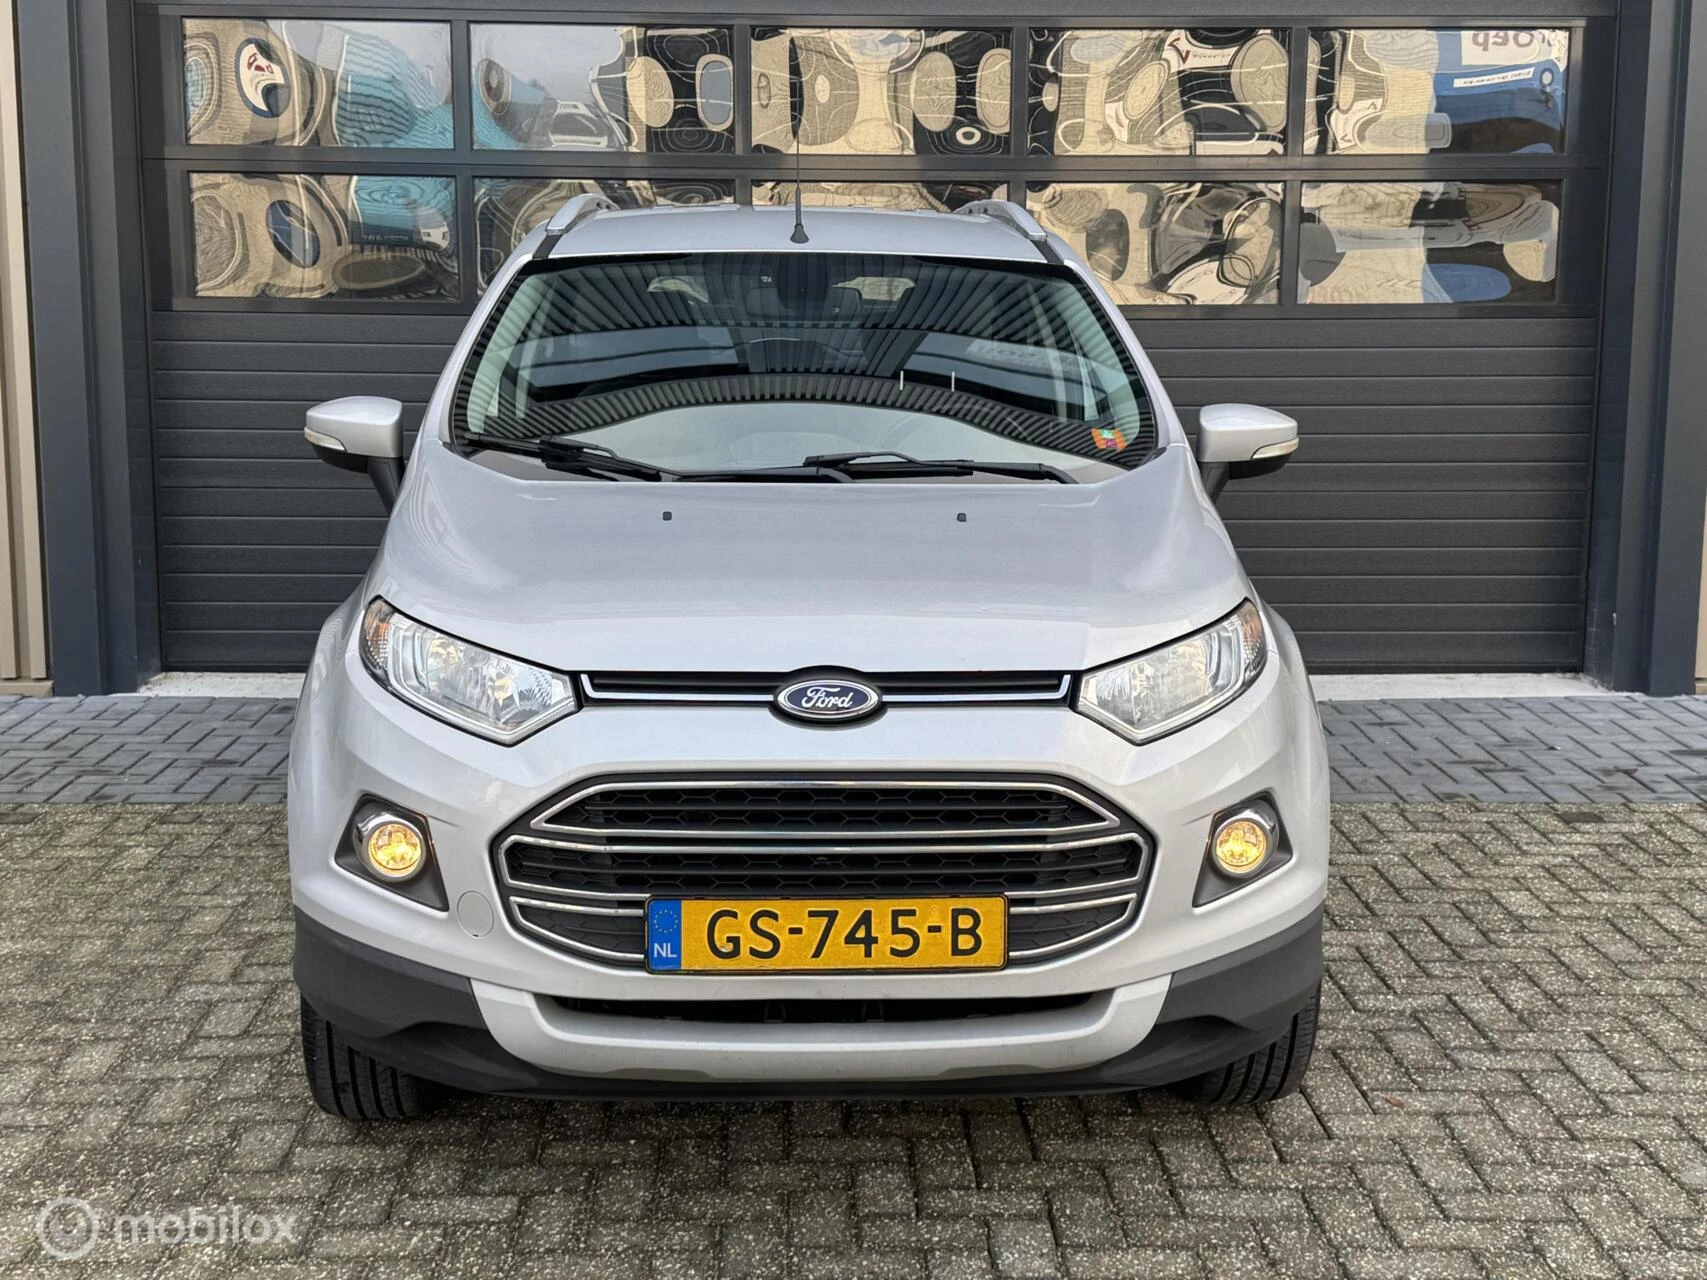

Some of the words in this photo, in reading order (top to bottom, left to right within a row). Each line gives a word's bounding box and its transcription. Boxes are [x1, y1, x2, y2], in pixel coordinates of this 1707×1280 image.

[801, 686, 854, 708] Ford
[706, 907, 983, 960] GS-745-B
[653, 942, 677, 958] NL
